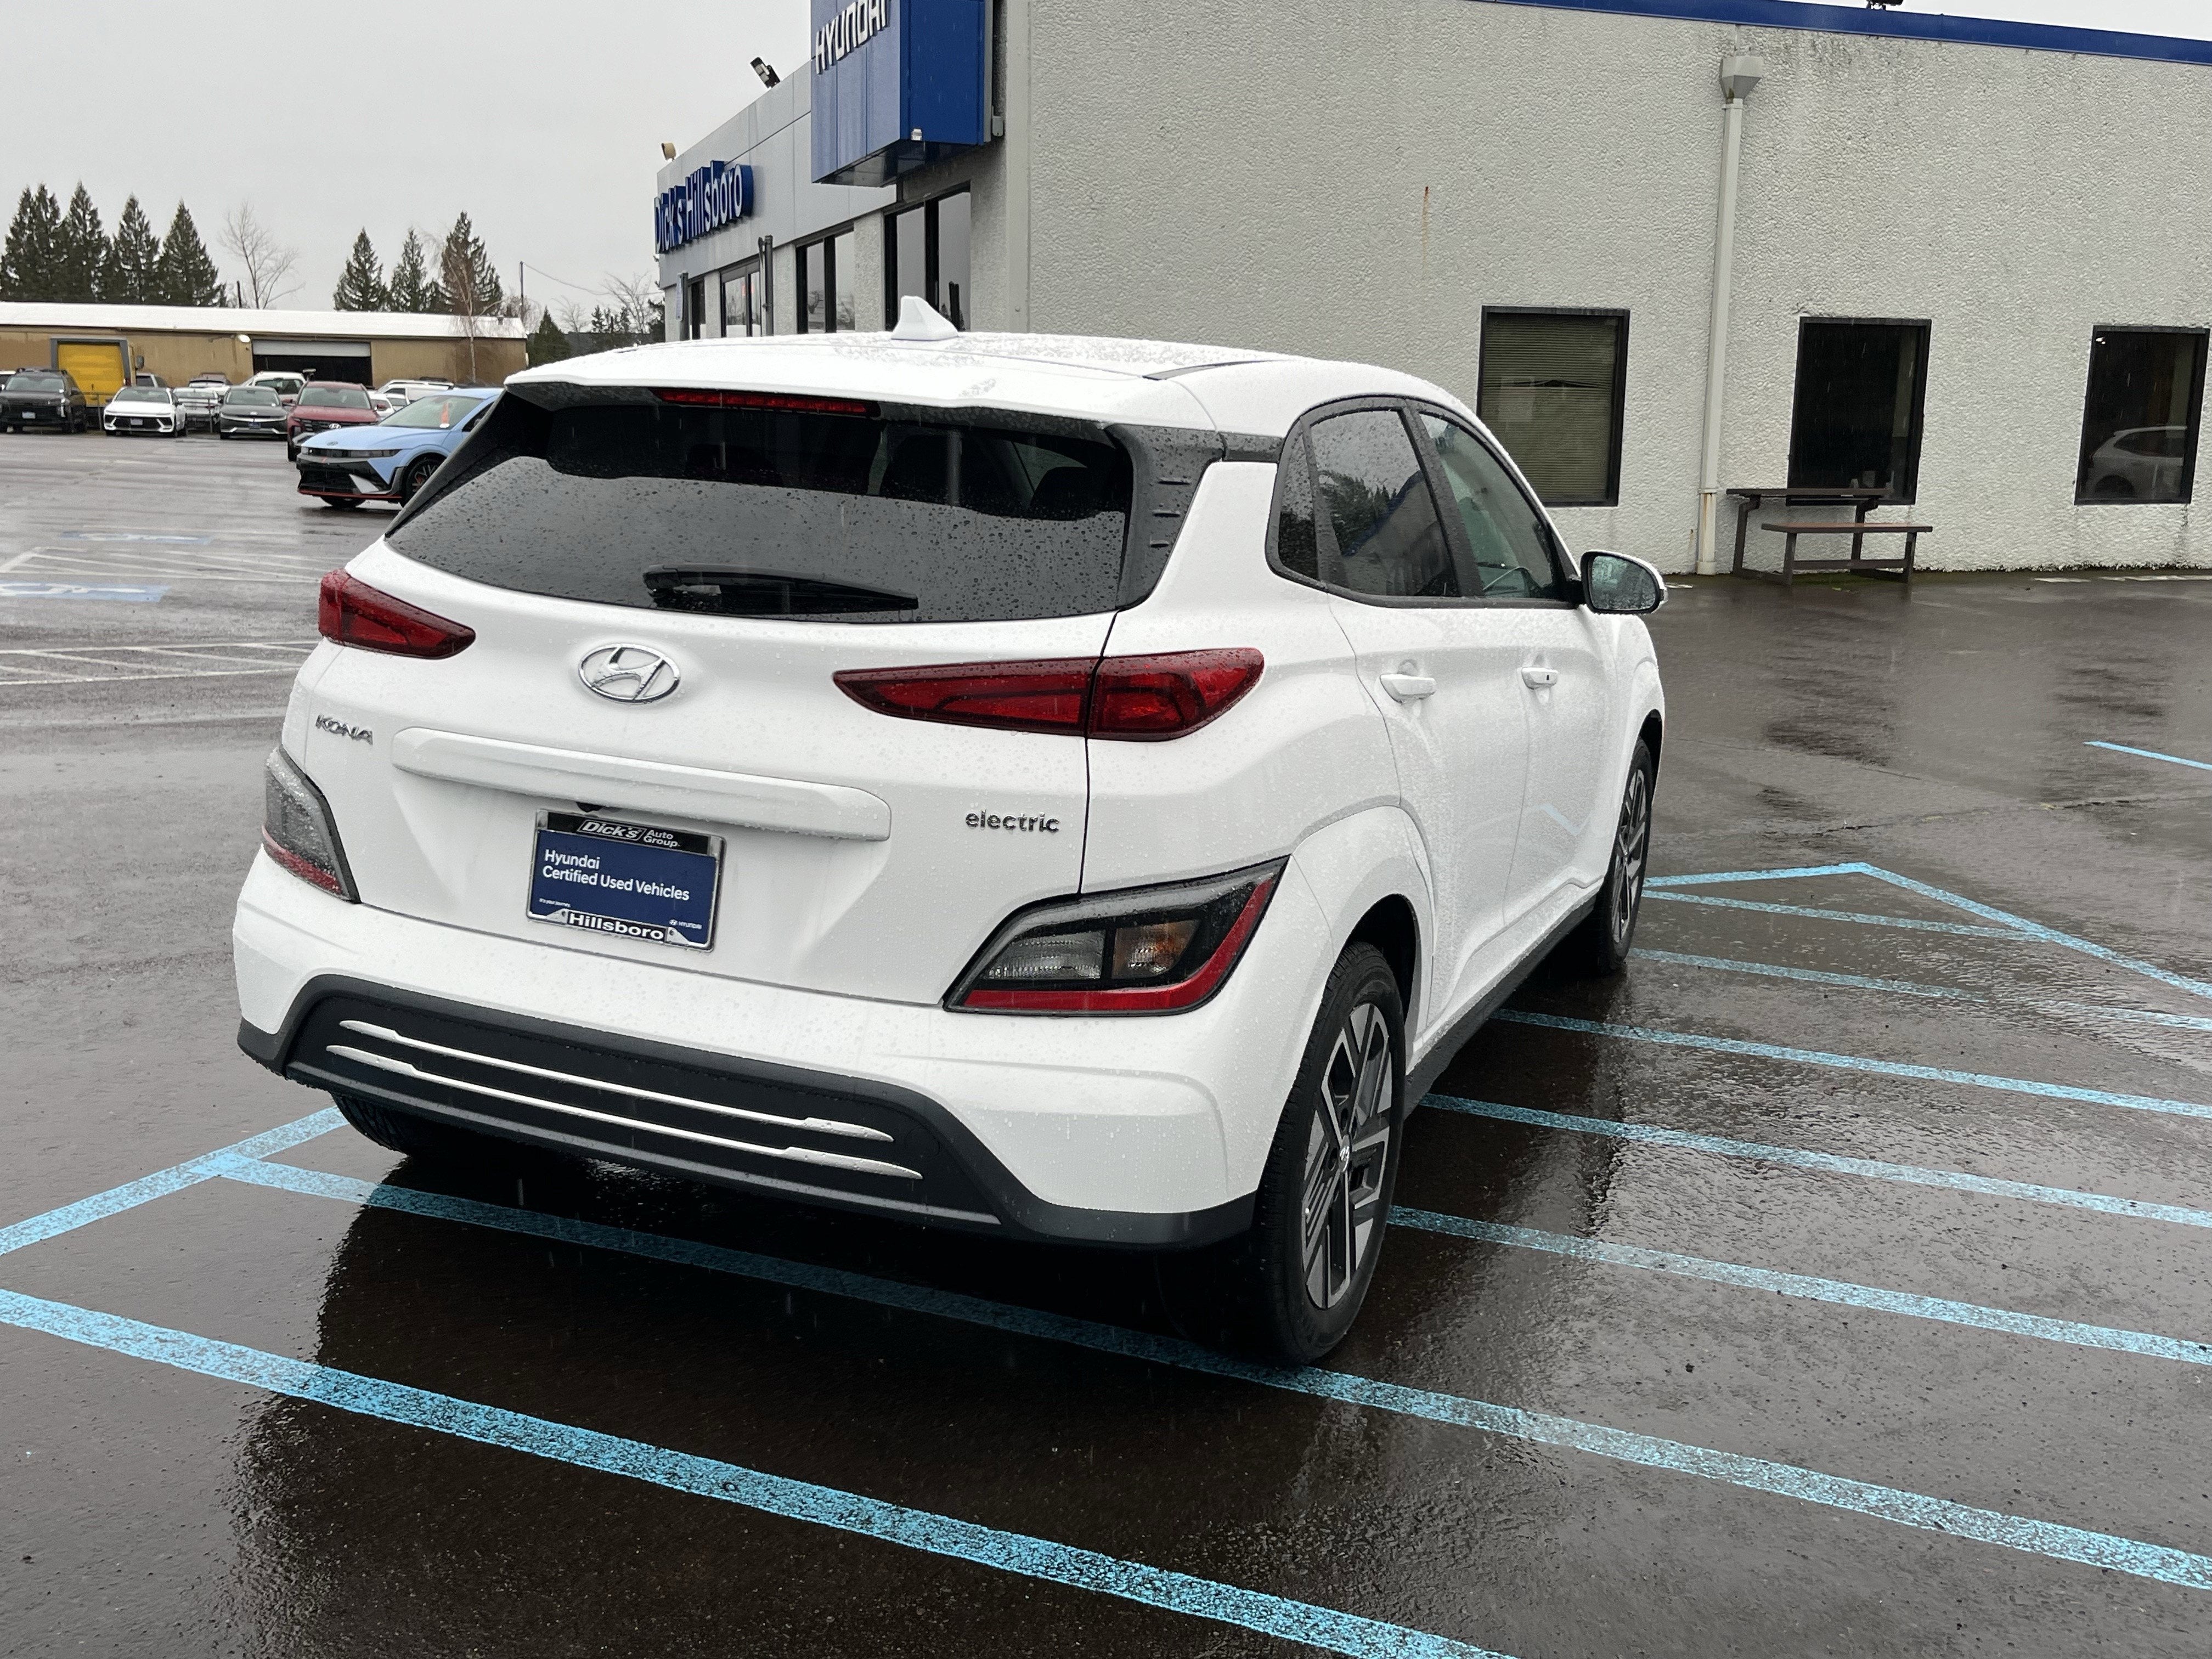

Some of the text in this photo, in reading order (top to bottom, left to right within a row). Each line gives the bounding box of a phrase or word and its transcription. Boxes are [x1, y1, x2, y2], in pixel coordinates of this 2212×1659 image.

[816, 0, 886, 74] HYUNDAI
[654, 161, 743, 253] Dick's Hillsboro
[315, 713, 374, 745] KONA
[647, 830, 674, 839] Auto
[966, 809, 1060, 834] electric
[644, 836, 679, 848] Group
[544, 849, 601, 870] Hyundai
[543, 865, 690, 901] Certified Used Vehicles
[569, 913, 664, 940] Hillsboro
